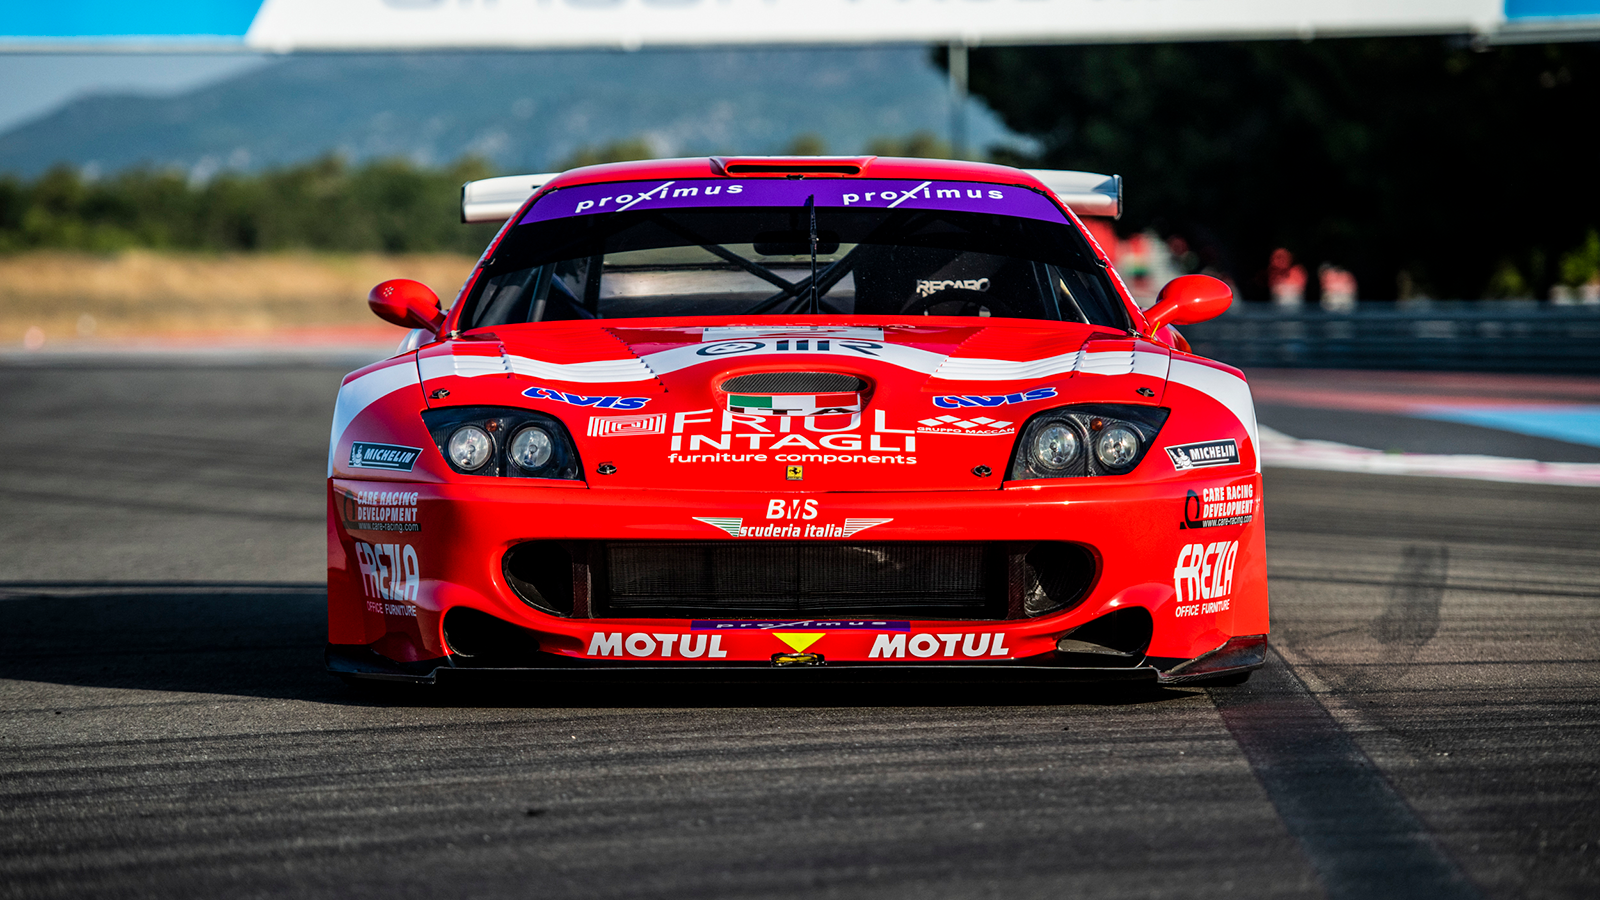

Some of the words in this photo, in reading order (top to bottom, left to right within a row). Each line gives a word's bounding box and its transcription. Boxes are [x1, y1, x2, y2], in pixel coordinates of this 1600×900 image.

[574, 181, 744, 213] proximus
[842, 181, 1004, 209] proximus
[672, 408, 916, 434] FRIUL
[670, 433, 916, 452] INTAGLI
[363, 448, 416, 464] MICHELIN
[668, 453, 768, 464] furniture
[774, 453, 917, 465] components
[1189, 444, 1236, 461] MICHELIN
[357, 490, 379, 505] CARE
[380, 491, 419, 506] RACING
[1203, 487, 1225, 503] CARE
[1226, 484, 1253, 500] RACING
[357, 506, 418, 522] DEVELOPMENT
[766, 498, 819, 520] BMS
[1202, 499, 1254, 519] DEVELOPMENT
[739, 523, 801, 538] scuderia
[804, 523, 844, 538] italia
[366, 600, 384, 614] OFFICE
[385, 603, 417, 617] FURNITURE
[1175, 603, 1200, 618] OFFICE
[1201, 598, 1231, 615] FURNITURE
[586, 632, 728, 659] MOTUL
[868, 632, 1010, 659] MOTUL
